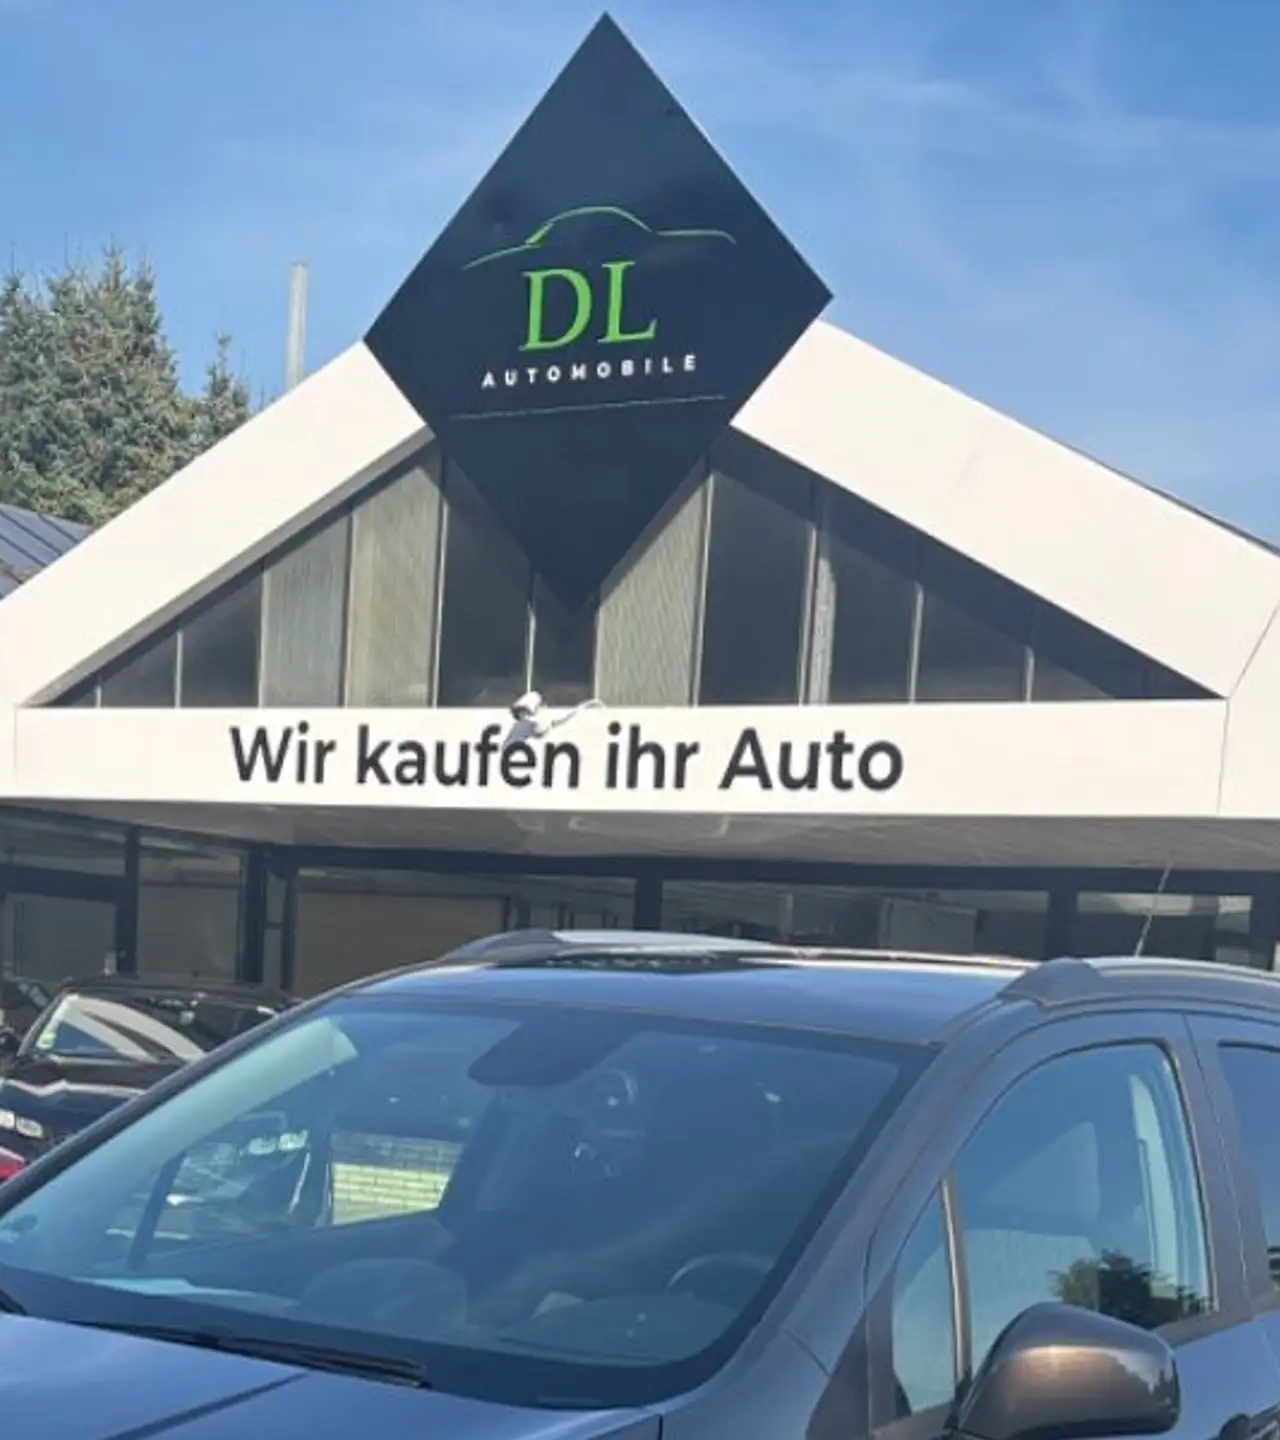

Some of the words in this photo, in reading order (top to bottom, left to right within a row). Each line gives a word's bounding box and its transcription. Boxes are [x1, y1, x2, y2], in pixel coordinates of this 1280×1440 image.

[519, 261, 657, 351] DL
[481, 354, 697, 388] AUTOMOBILE
[229, 721, 336, 784] Wir
[356, 724, 580, 789] kaufen
[605, 722, 699, 789] ihr
[719, 727, 903, 790] Auto
